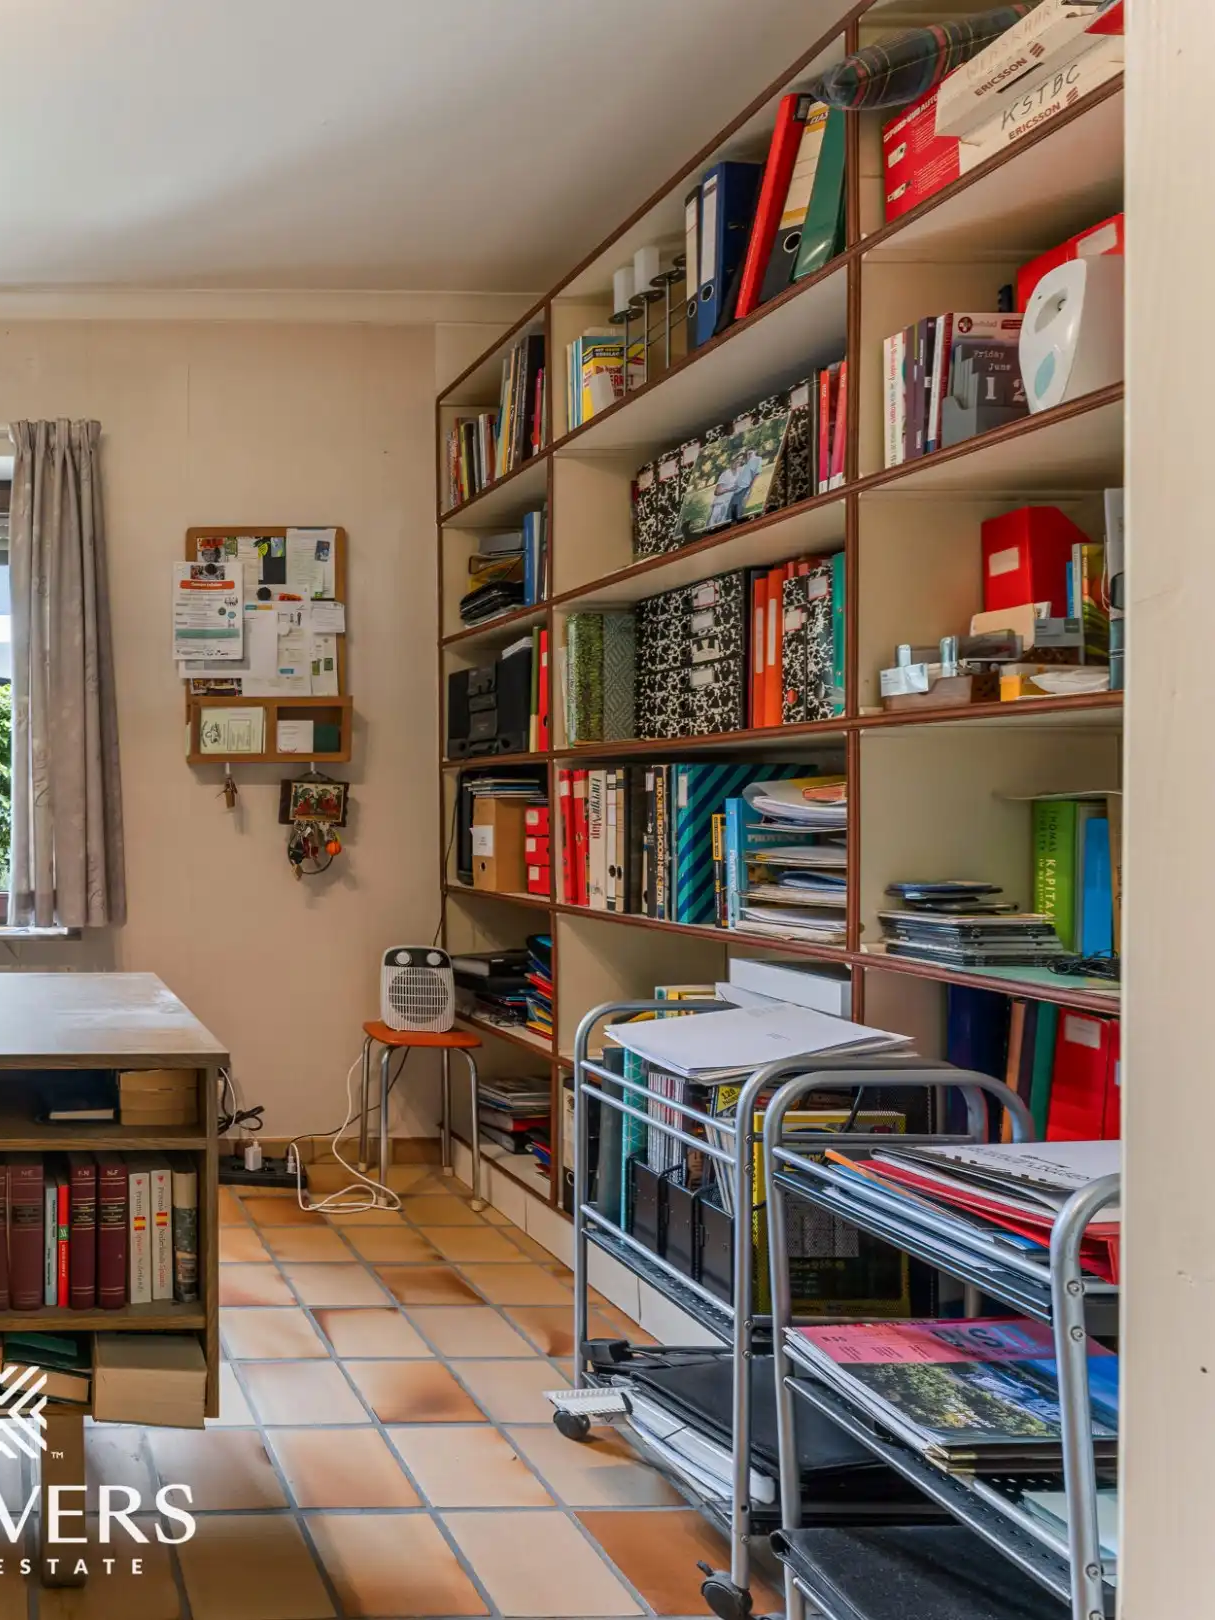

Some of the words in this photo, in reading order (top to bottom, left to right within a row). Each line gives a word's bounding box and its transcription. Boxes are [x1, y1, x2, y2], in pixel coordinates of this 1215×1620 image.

[974, 58, 1028, 96] ERICSSON
[1000, 64, 1081, 130] KSTBC
[1008, 102, 1061, 140] ERICSSON
[973, 349, 1005, 360] Friday
[988, 363, 1012, 371] June
